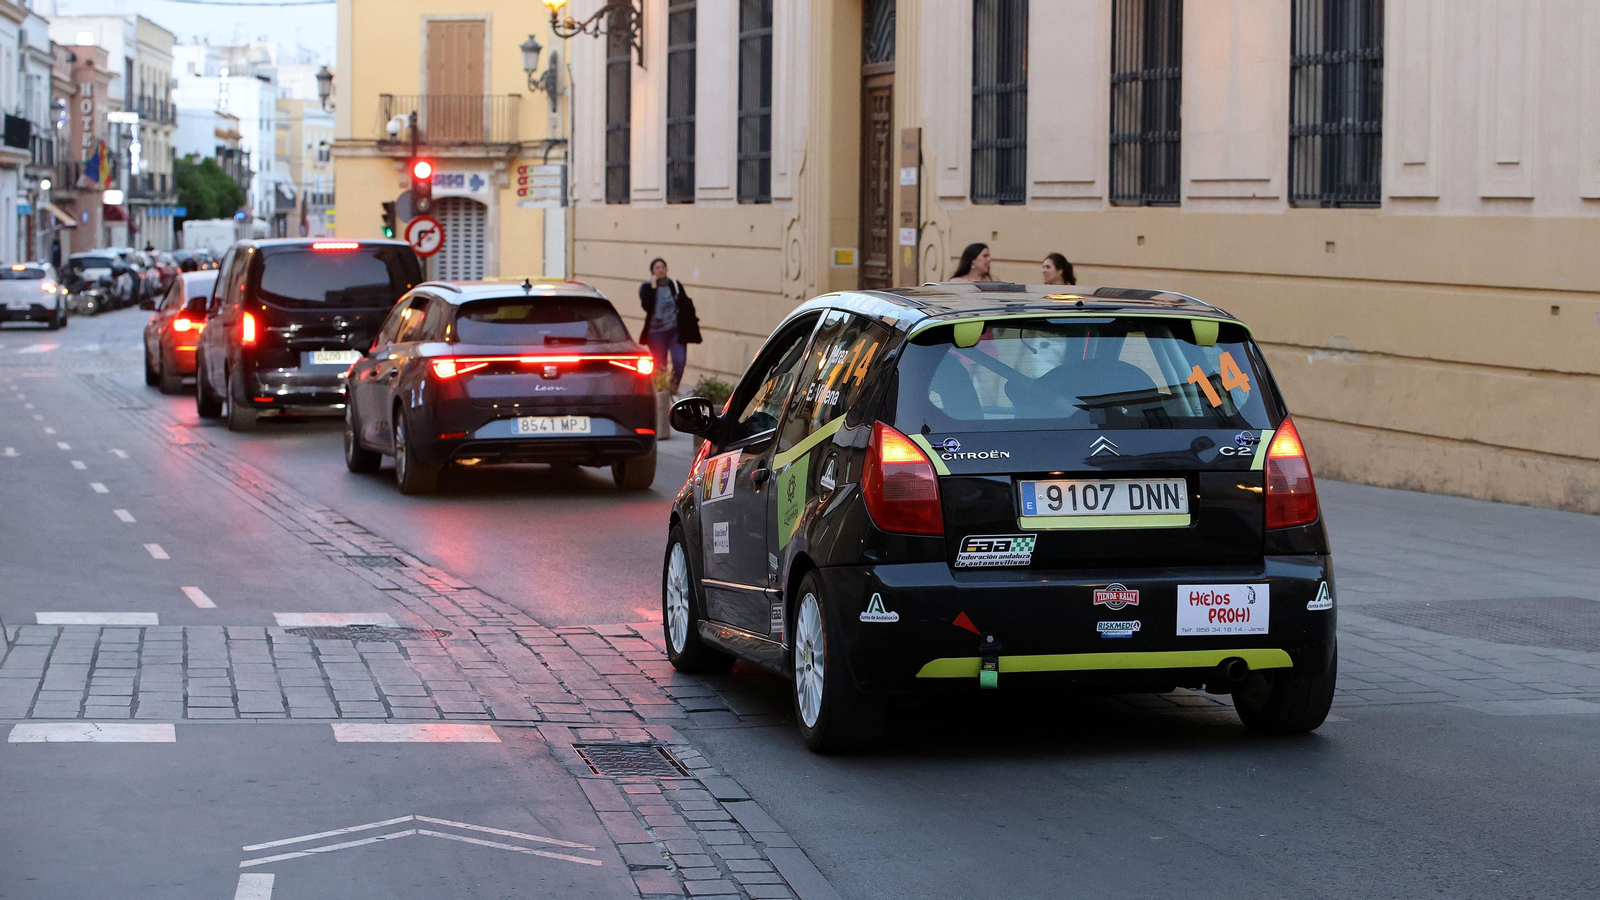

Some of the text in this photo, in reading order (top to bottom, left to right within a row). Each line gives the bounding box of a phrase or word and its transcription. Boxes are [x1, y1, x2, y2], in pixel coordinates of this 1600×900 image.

[842, 338, 880, 387] 14
[1186, 351, 1251, 408] 14
[521, 418, 587, 431] 8541 MPJ
[941, 449, 1010, 460] CITROËN
[1219, 446, 1252, 456] C2
[1026, 483, 1180, 511] E 9107 DNN
